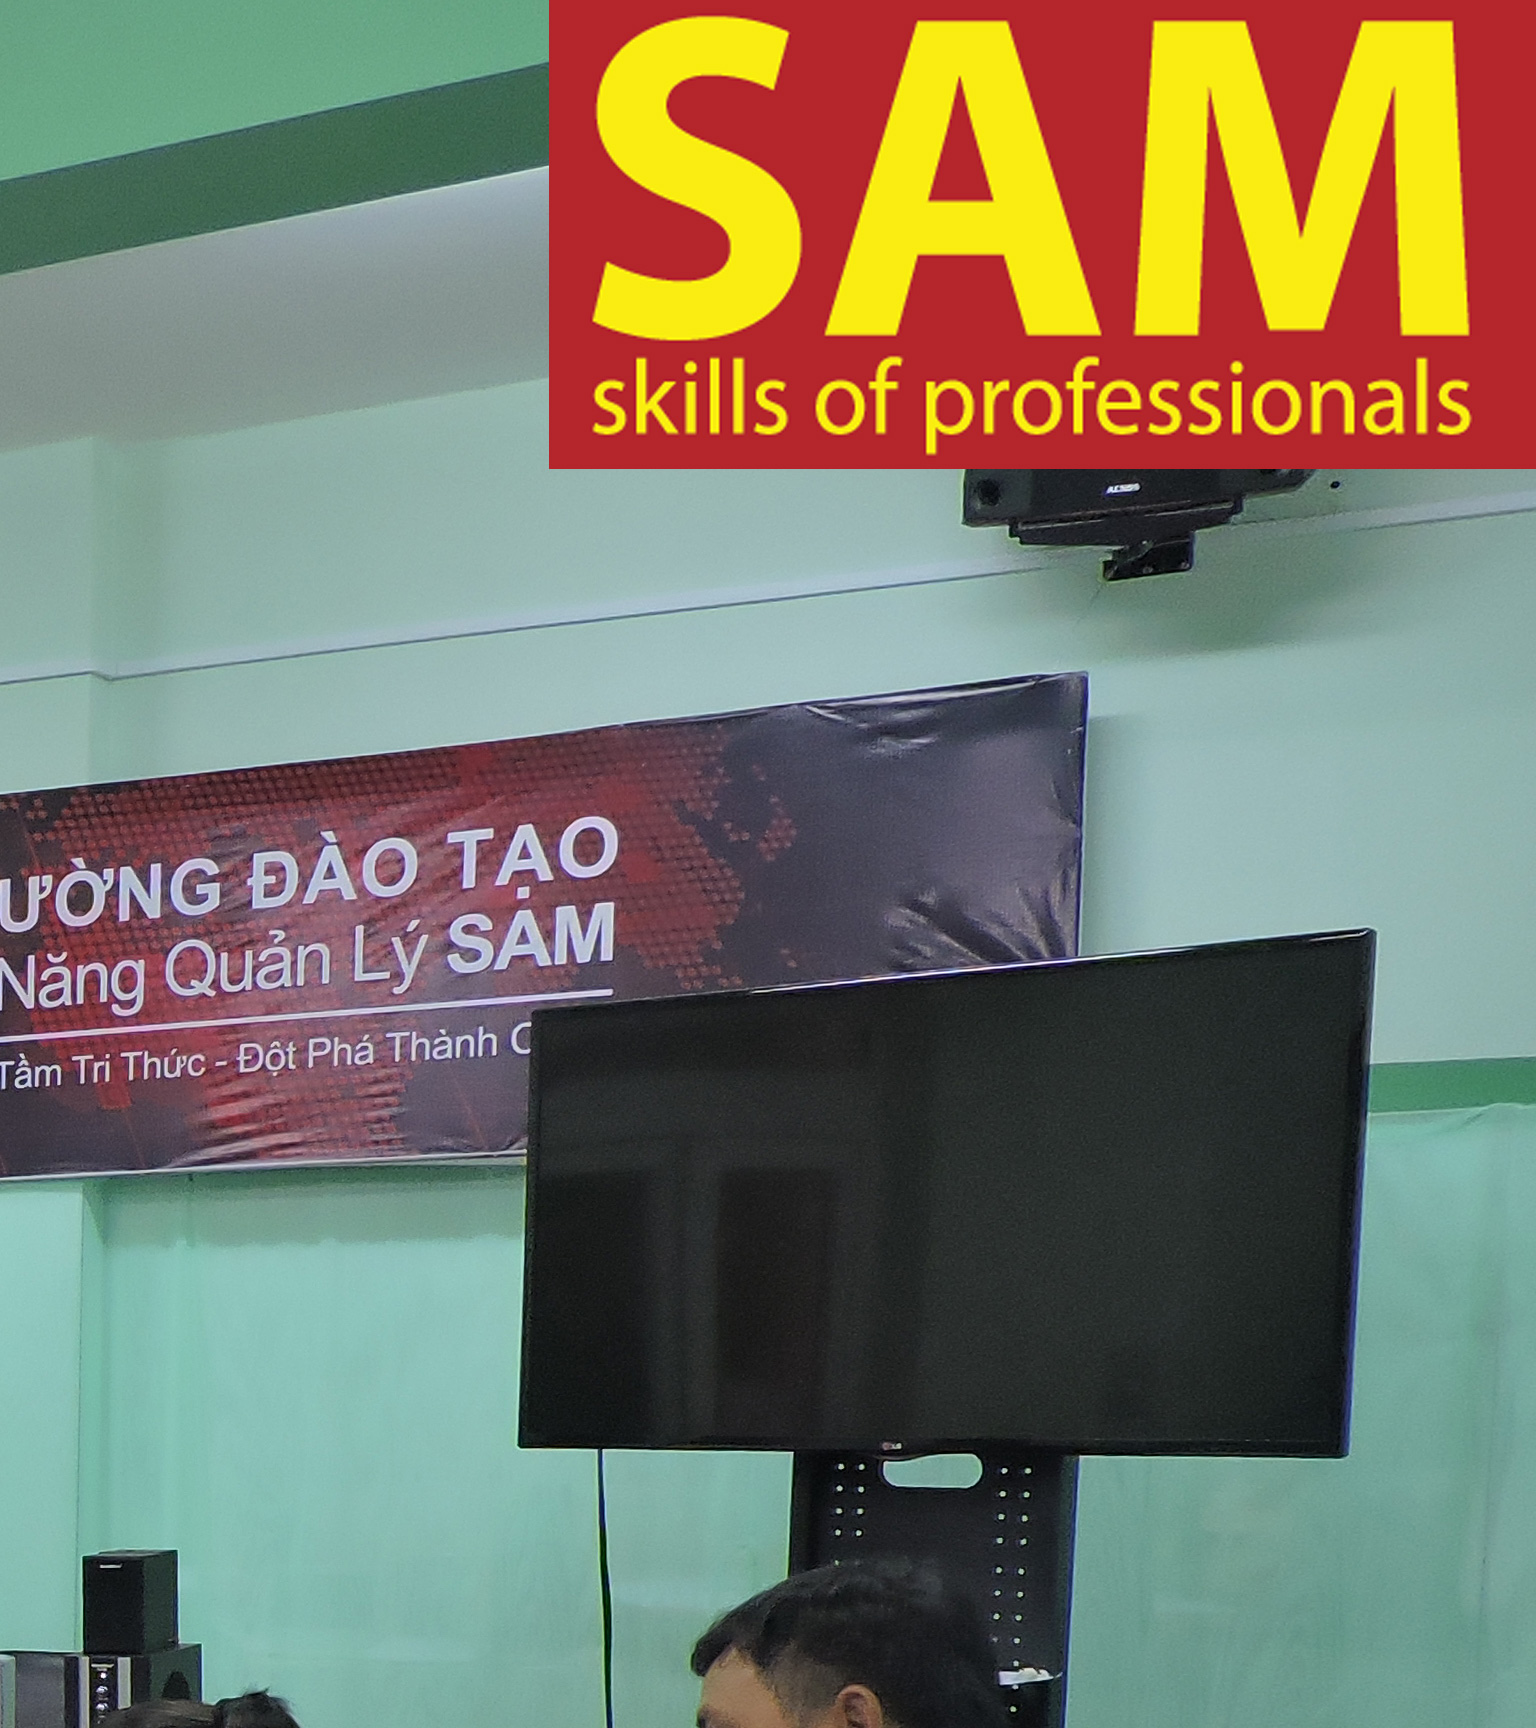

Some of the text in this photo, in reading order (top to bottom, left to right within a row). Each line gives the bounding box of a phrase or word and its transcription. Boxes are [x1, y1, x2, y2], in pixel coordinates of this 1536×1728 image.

[246, 830, 419, 910] ĐÀO
[446, 815, 620, 899] TẠO
[165, 929, 331, 998] Quản
[353, 919, 429, 995] Lý
[446, 901, 616, 975] SAM
[71, 1054, 111, 1085] Tri
[120, 1048, 207, 1082] Thức
[237, 1041, 297, 1077] Đột
[307, 1034, 375, 1069] Phá
[385, 1025, 498, 1063] Thành
